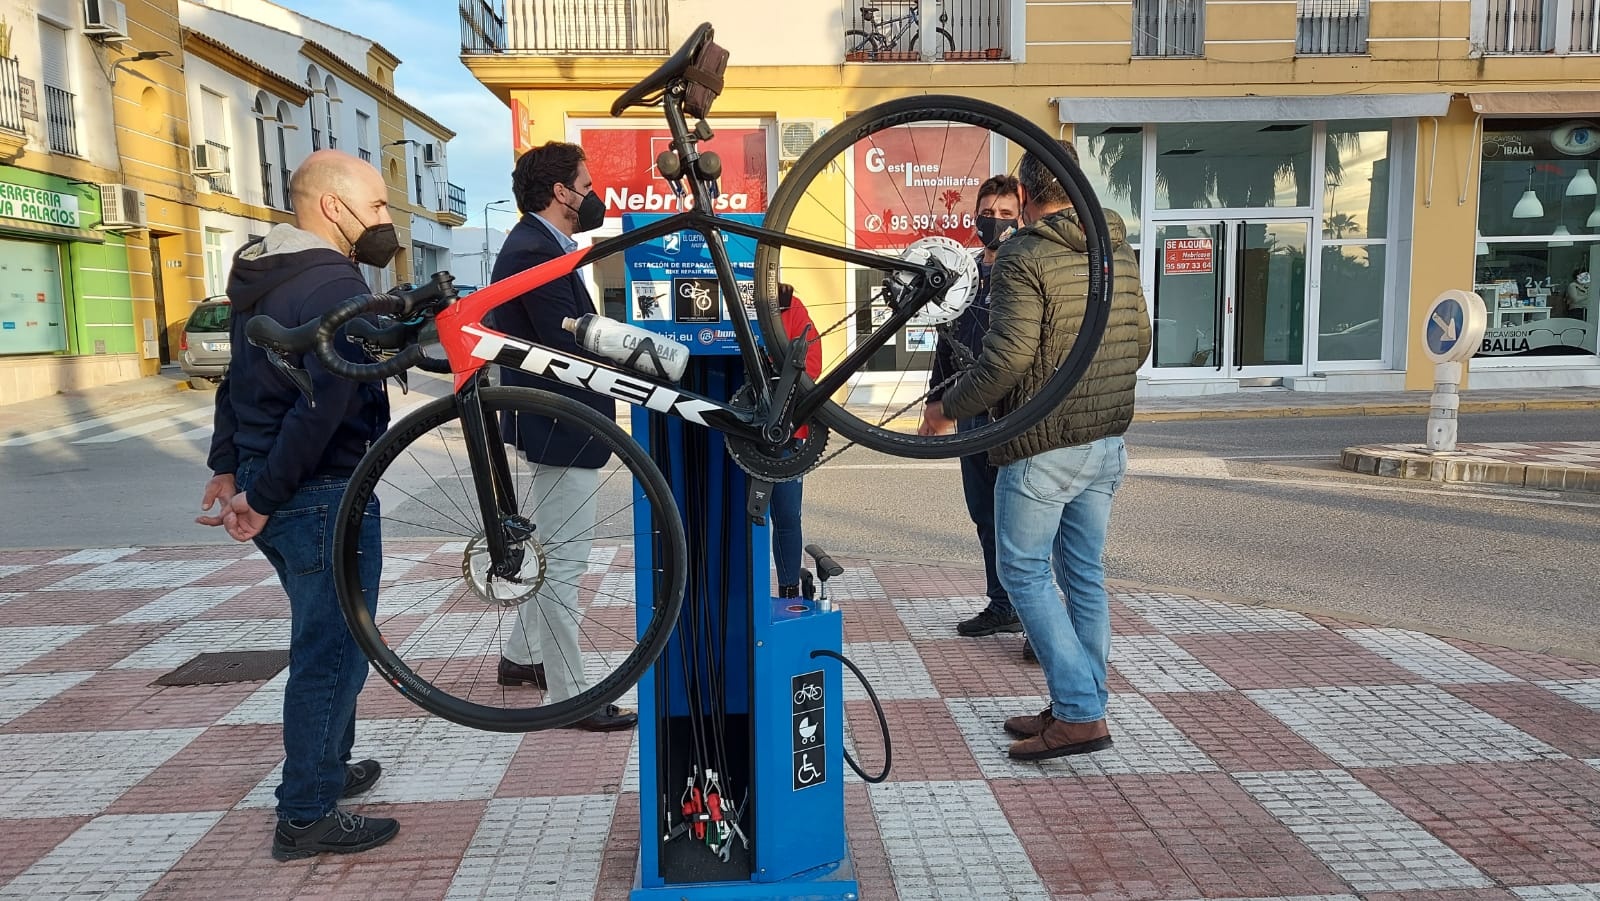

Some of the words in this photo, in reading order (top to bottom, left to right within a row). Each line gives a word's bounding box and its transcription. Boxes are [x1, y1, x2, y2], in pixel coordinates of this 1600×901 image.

[1503, 145, 1534, 155] IBALLA
[0, 183, 61, 208] ERRETERIA
[21, 203, 75, 225] PALACIOS
[891, 215, 908, 231] 95
[912, 215, 938, 230] 597
[942, 214, 959, 229] 33
[1166, 241, 1177, 249] SE
[1178, 240, 1212, 249] ALQUILA
[460, 324, 725, 428] TREK
